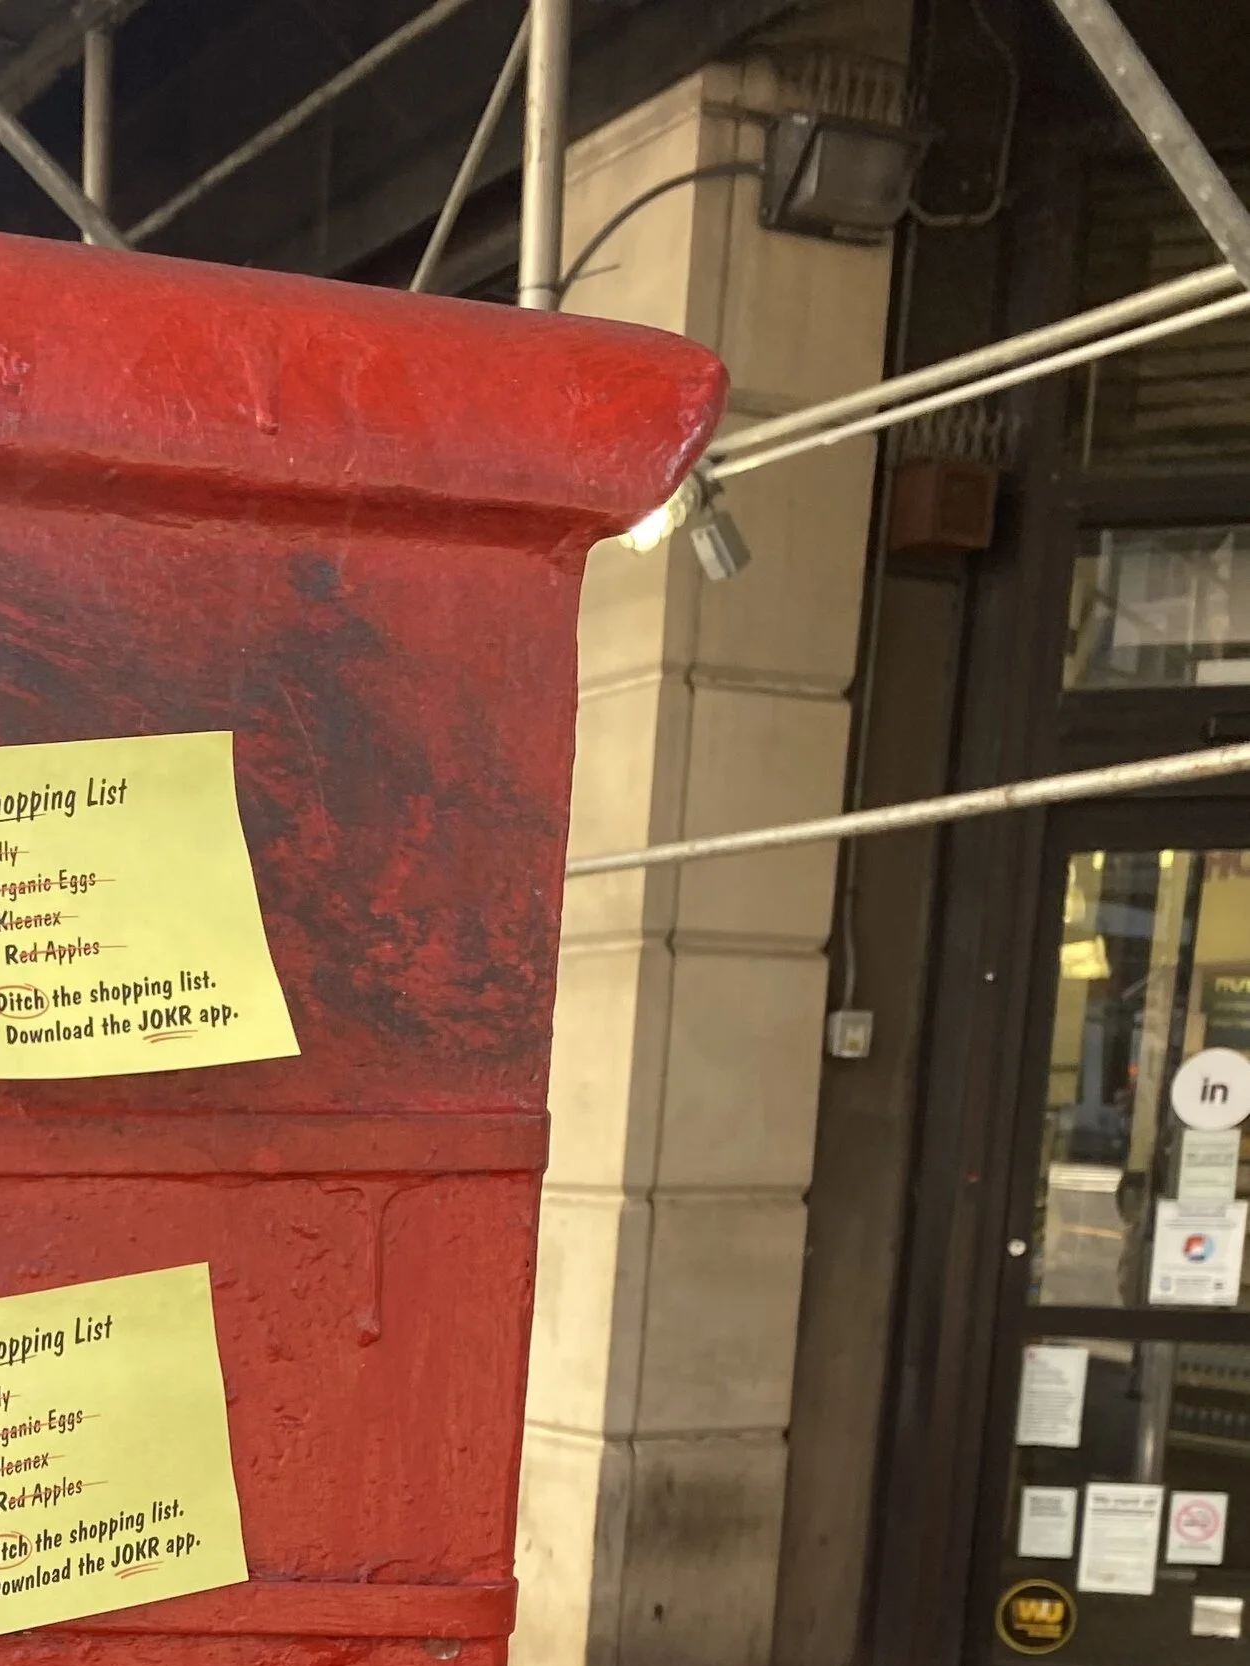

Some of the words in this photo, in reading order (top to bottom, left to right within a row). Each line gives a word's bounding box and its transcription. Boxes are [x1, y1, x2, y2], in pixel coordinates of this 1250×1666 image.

[87, 778, 128, 807] List
[58, 870, 96, 894] Eggs
[5, 943, 38, 964] Red
[45, 937, 100, 963] Apples
[52, 985, 82, 1008] the
[89, 975, 173, 1006] shopping
[180, 971, 217, 994] list.
[6, 1017, 94, 1045] Download
[102, 1012, 131, 1034] the
[138, 1004, 192, 1031] JOKR
[199, 1006, 239, 1026] app.
[1200, 1077, 1229, 1104] in
[74, 1315, 113, 1344] List
[48, 1408, 83, 1434] Eggs
[31, 1476, 83, 1508] Apples
[35, 1529, 62, 1553] the
[69, 1509, 145, 1544] shopping
[151, 1499, 184, 1523] list.
[78, 1550, 105, 1575] the
[111, 1536, 160, 1568] JOKR
[166, 1530, 201, 1556] app.
